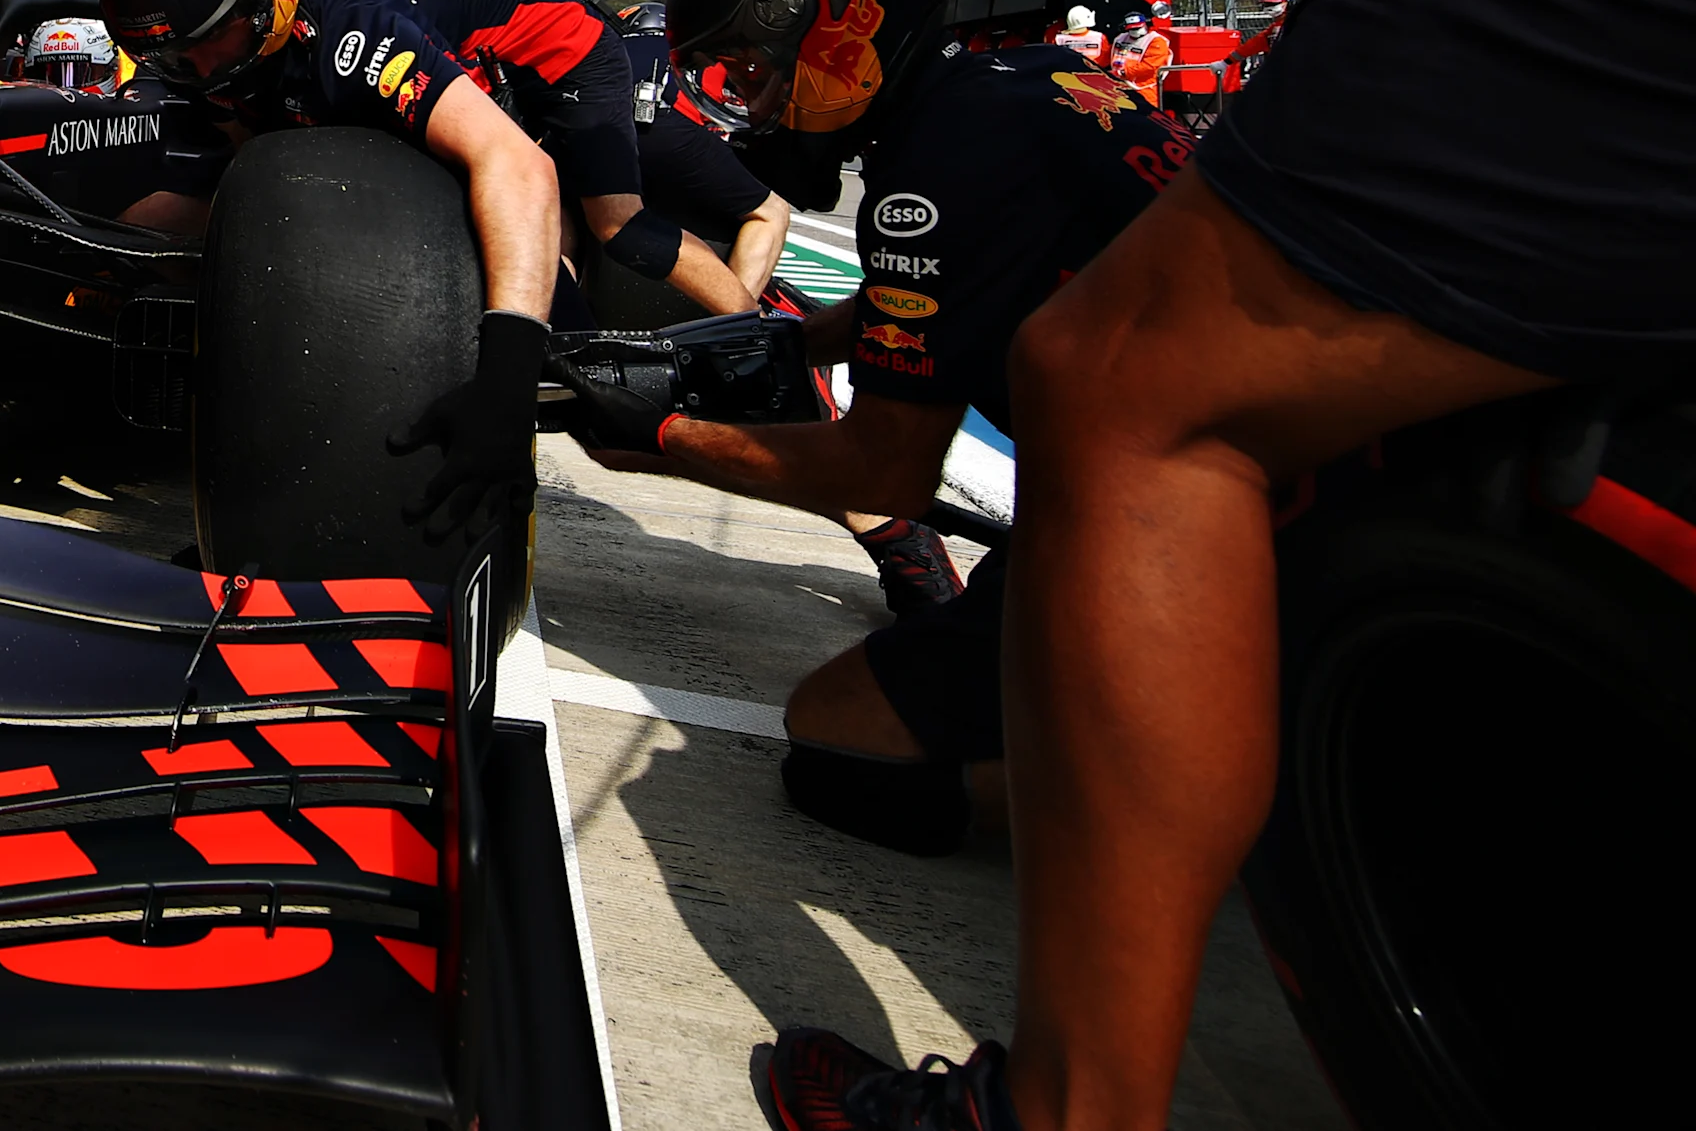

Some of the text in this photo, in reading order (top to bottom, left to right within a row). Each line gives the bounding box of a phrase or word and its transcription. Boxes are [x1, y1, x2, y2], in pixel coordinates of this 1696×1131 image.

[43, 42, 79, 52] Red Bull
[47, 113, 161, 157] ASTON MARTIN
[881, 291, 926, 313] RAUCH
[855, 340, 935, 378] Red Bull
